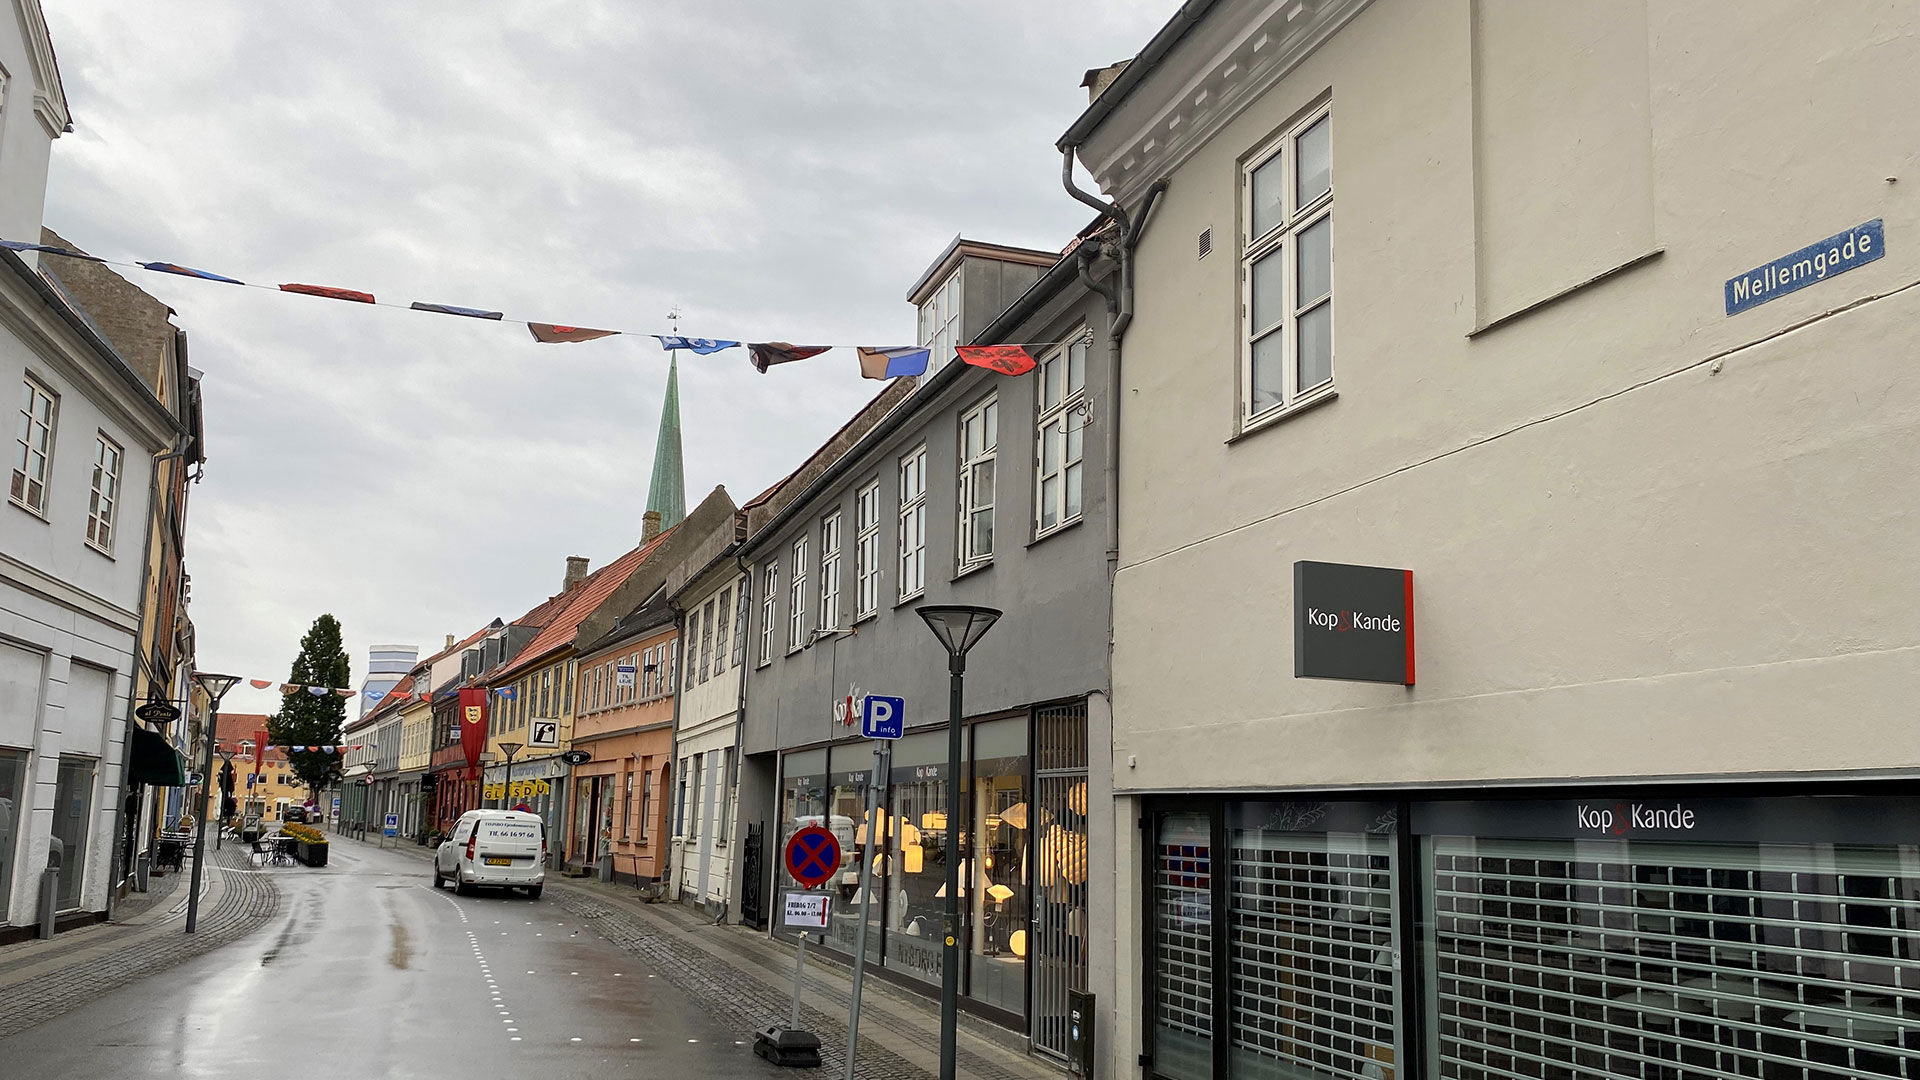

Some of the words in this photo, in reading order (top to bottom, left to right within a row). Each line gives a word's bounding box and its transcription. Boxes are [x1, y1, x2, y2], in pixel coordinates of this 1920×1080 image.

[1733, 232, 1872, 304] Mellemgade
[1308, 607, 1339, 631] Kop
[1353, 611, 1401, 633] Kande
[870, 700, 893, 732] P
[880, 726, 896, 734] info
[1577, 804, 1613, 834] Kop
[1631, 803, 1695, 829] Kande
